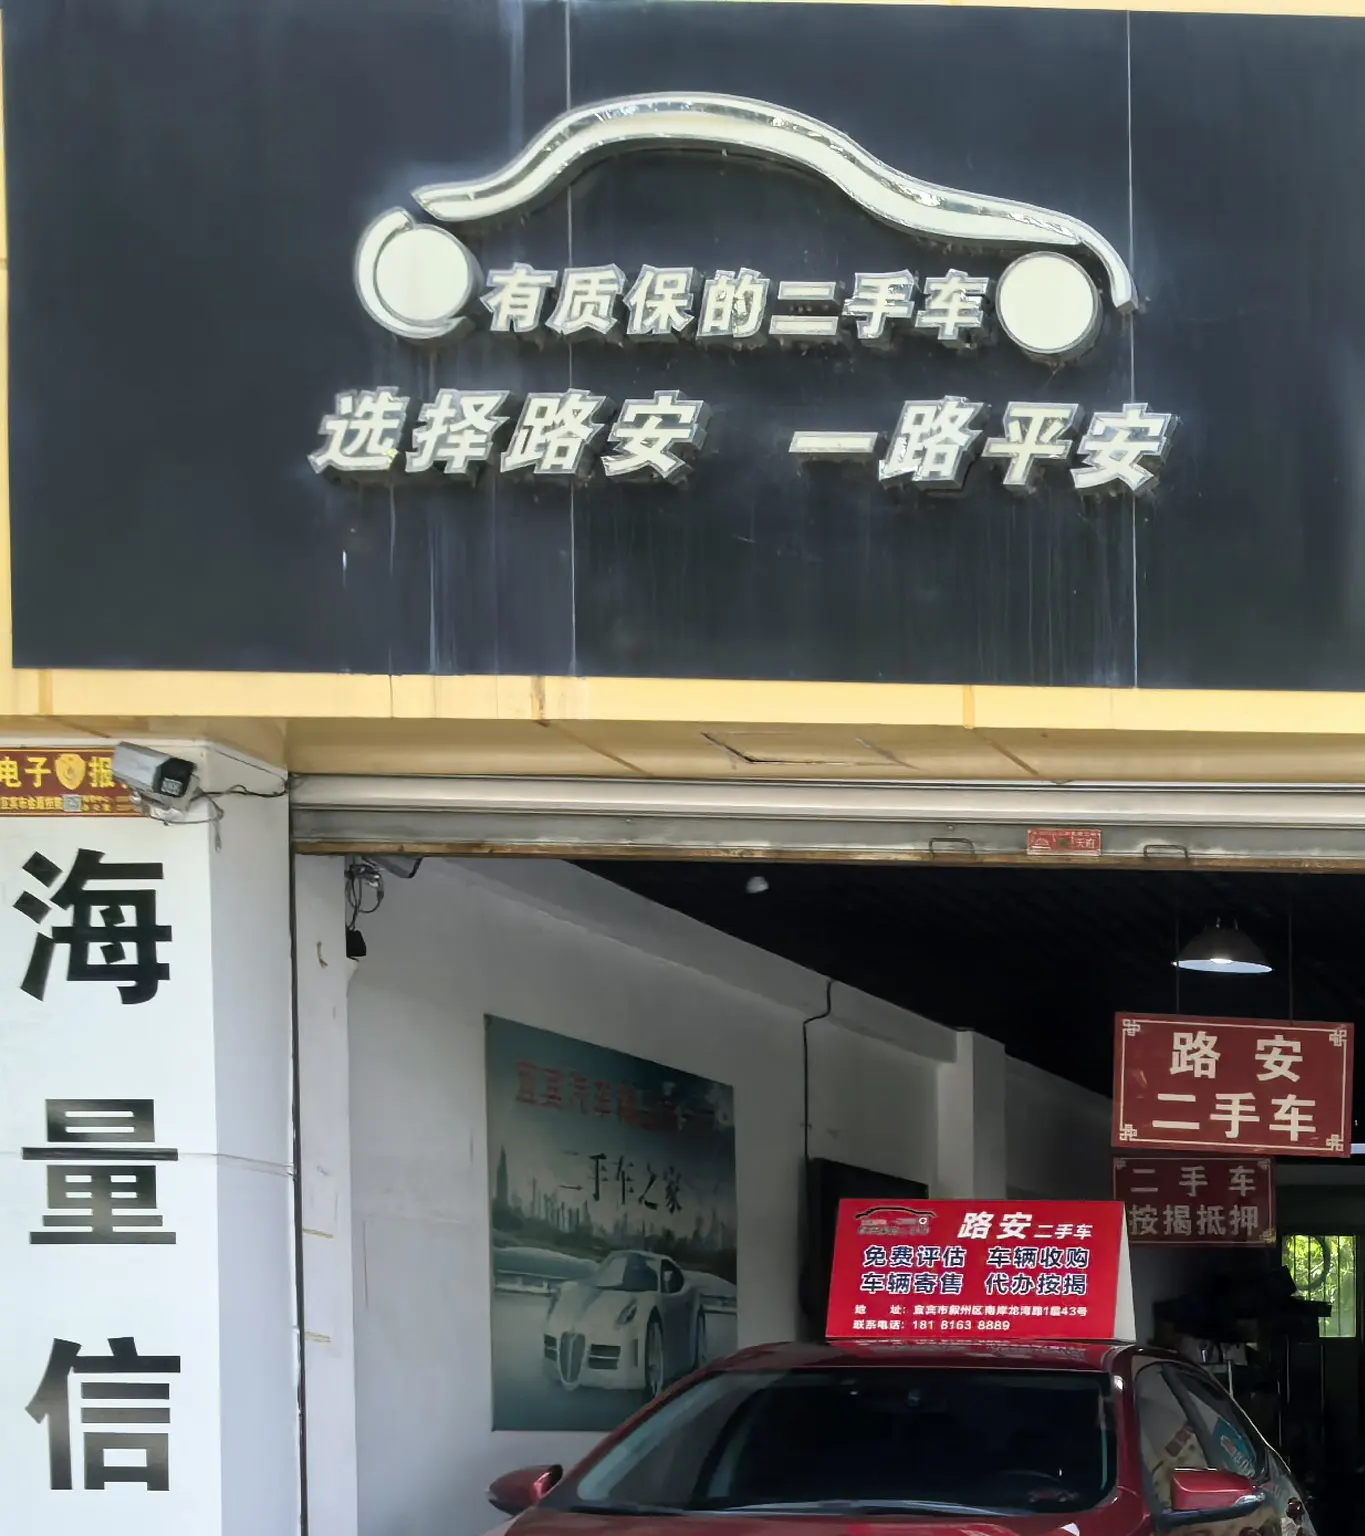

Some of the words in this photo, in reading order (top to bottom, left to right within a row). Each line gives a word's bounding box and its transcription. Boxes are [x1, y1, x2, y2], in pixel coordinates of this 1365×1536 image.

[480, 262, 990, 345] 有质保的二手车
[308, 386, 709, 485] 选择路安
[790, 396, 1183, 496] 一路平安
[88, 755, 128, 789] 报
[1169, 1031, 1304, 1083] 路安
[1152, 1092, 1317, 1142] 二手车
[1130, 1165, 1257, 1198] 二手车
[957, 1210, 1093, 1241] 路安二手车
[1129, 1204, 1260, 1237] 按揭抵押
[862, 1244, 967, 1269] 免费评估
[986, 1246, 1091, 1269] 车辆收购
[859, 1272, 965, 1296] 车辆寄售
[983, 1272, 1088, 1296] 代办按揭
[912, 1319, 934, 1331] 181
[940, 1319, 972, 1331] 8163
[977, 1319, 1011, 1331] 8889
